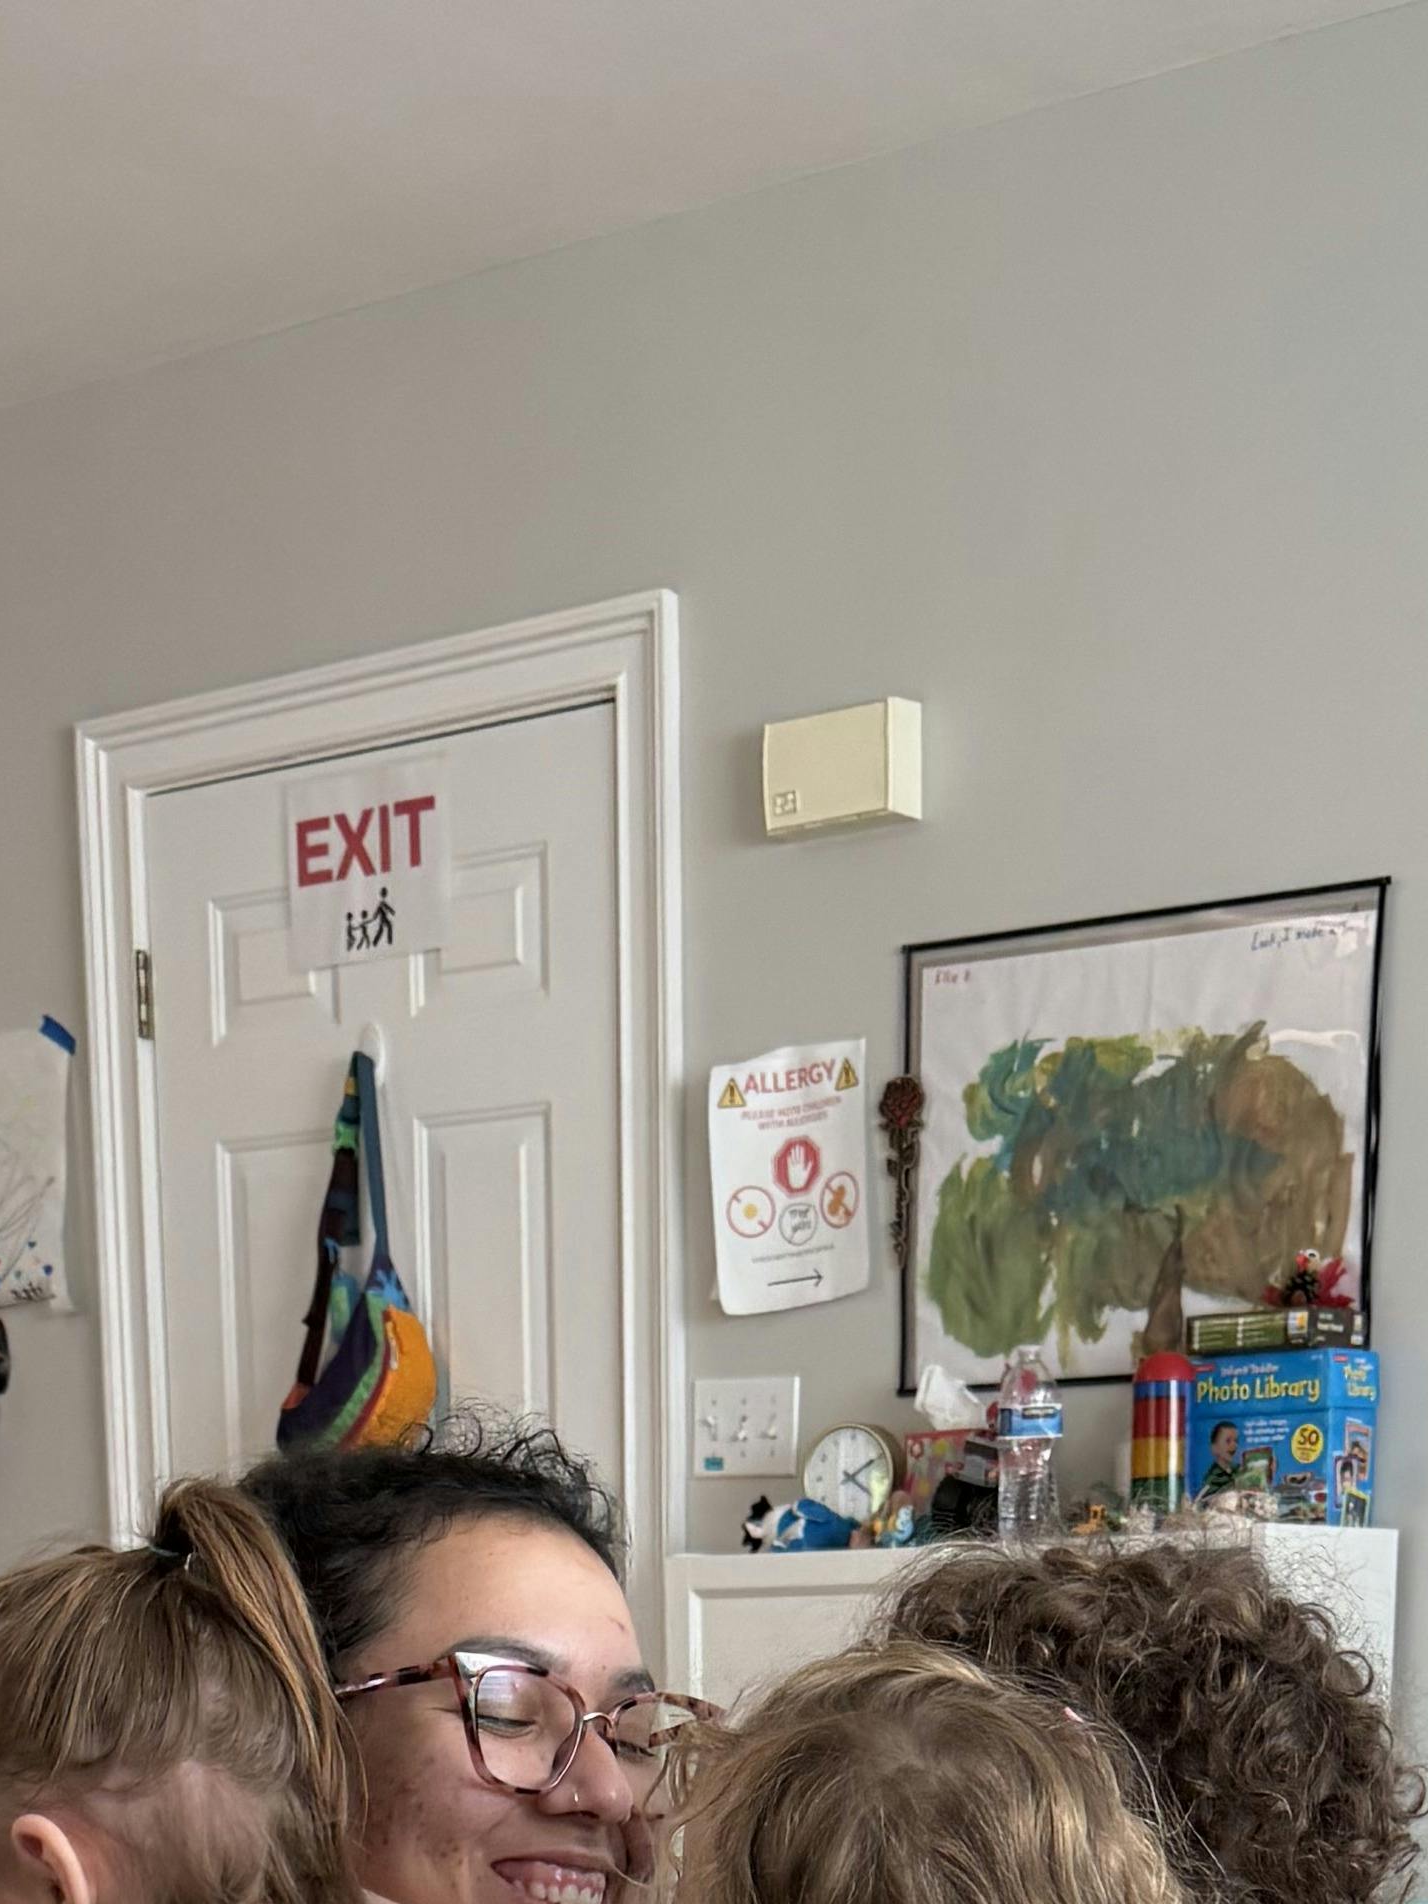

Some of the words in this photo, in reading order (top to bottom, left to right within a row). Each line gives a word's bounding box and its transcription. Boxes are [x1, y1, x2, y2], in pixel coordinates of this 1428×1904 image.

[295, 794, 436, 888] EXIT
[743, 1058, 836, 1095] ALLERGY
[1196, 1376, 1250, 1403] Photo
[1254, 1373, 1321, 1402] Library
[1297, 1427, 1320, 1446] 50
